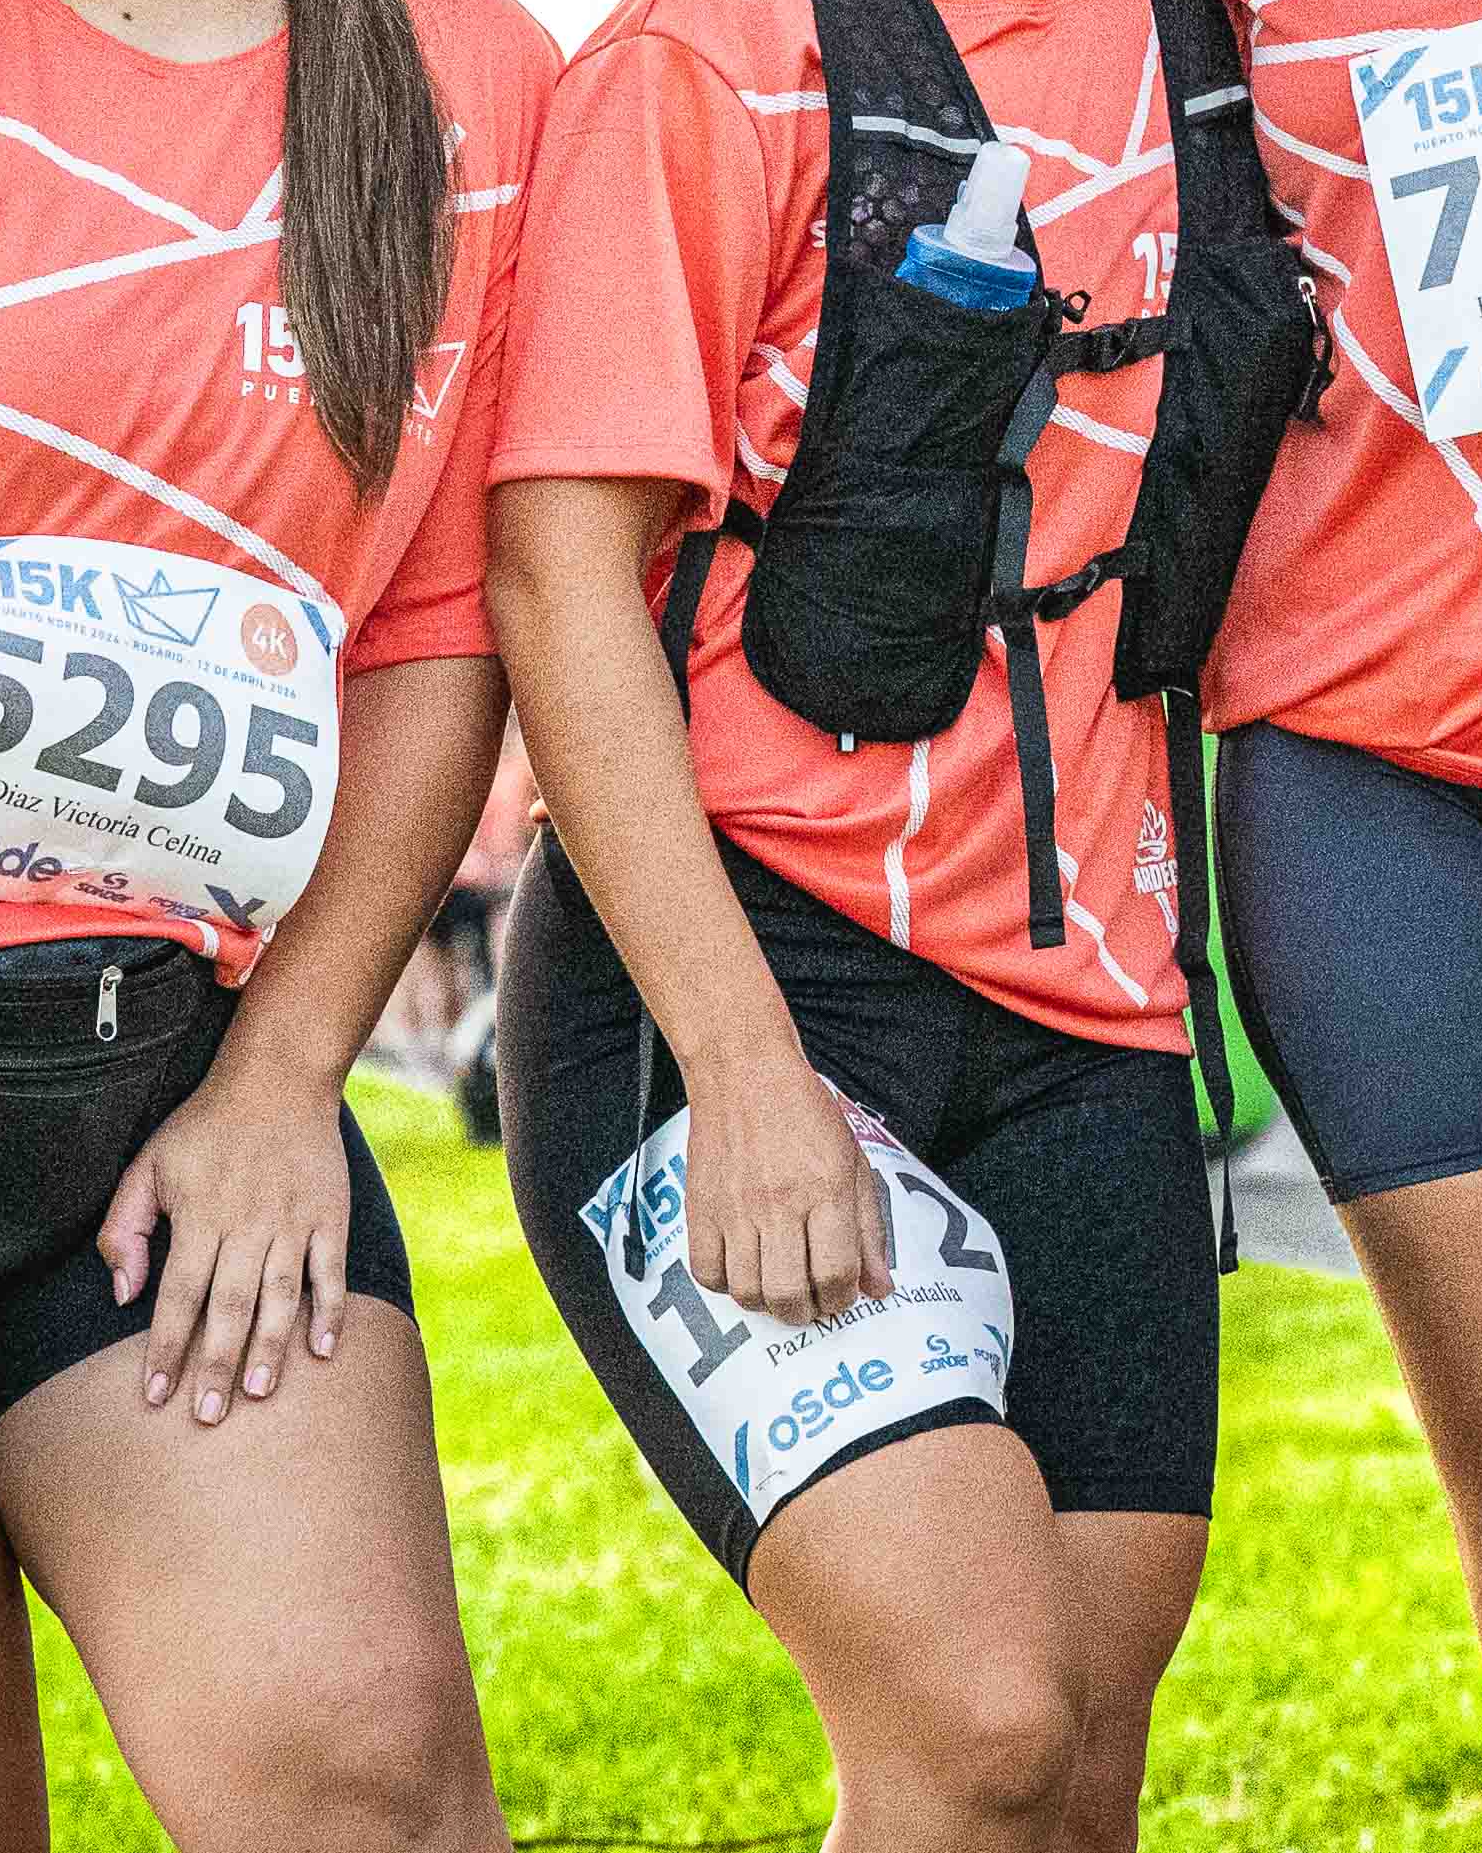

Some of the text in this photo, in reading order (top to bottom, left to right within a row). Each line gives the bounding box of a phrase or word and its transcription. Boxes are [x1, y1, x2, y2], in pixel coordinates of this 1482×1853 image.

[1413, 131, 1464, 154] PUERTO
[236, 302, 306, 378] 15
[47, 613, 87, 636] NORTE
[133, 640, 183, 662] ROSARIO
[198, 660, 209, 672] 12
[215, 666, 228, 677] DE
[233, 673, 265, 689] ABRIL
[270, 683, 296, 699] 2026
[252, 626, 288, 660] 4K
[53, 798, 142, 839] Victoria
[147, 825, 222, 865] Celina
[646, 1226, 684, 1263] PUERTO
[647, 1167, 999, 1388] 12
[766, 1331, 814, 1368] Paz
[892, 1281, 964, 1309] Natalia
[768, 1358, 894, 1451] osde
